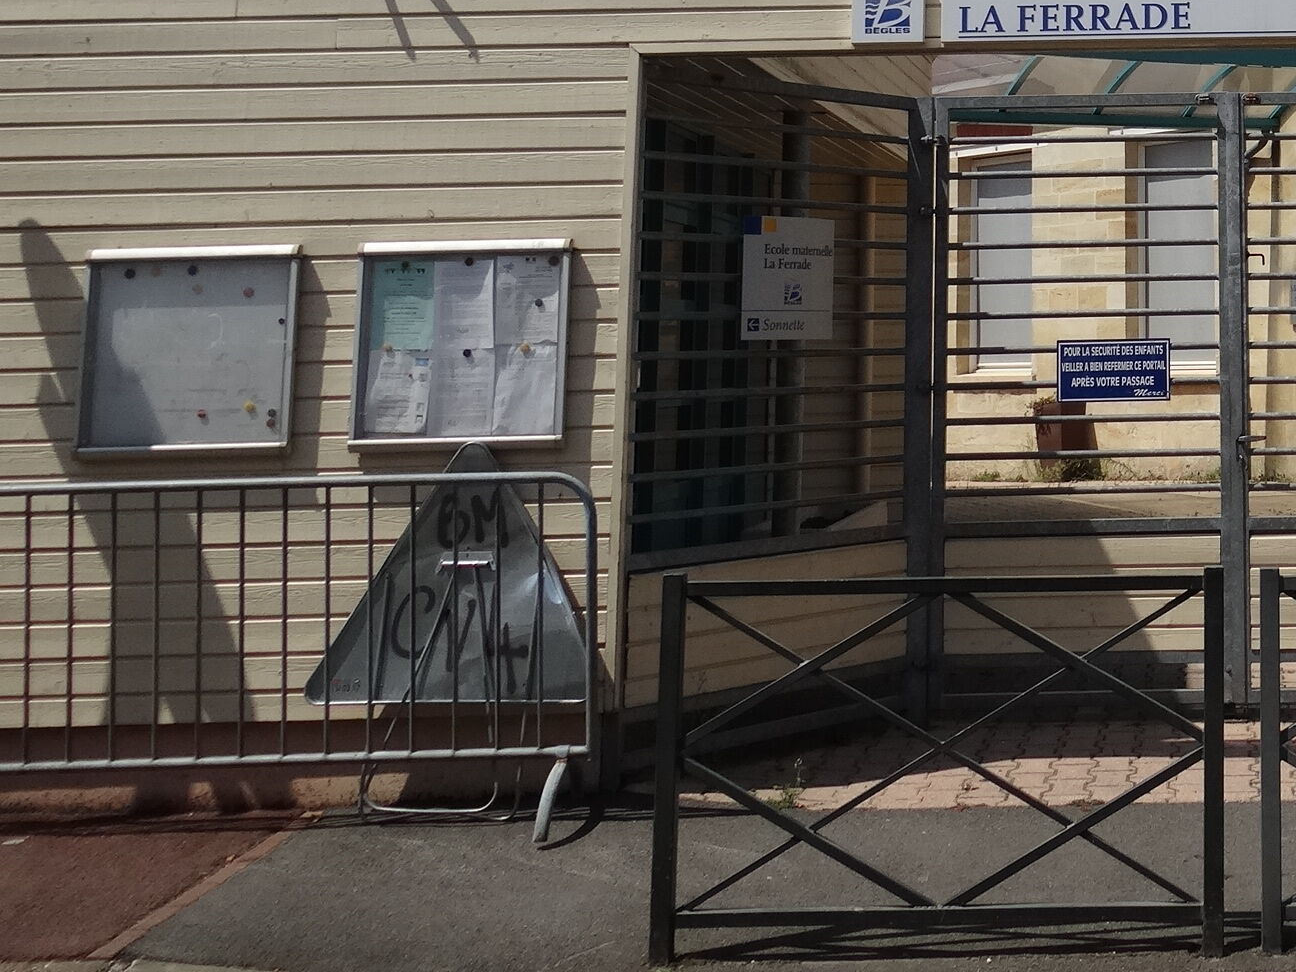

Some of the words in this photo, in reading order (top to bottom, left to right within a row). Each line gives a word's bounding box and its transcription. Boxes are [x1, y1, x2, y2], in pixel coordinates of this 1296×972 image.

[959, 5, 1005, 33] LA
[1017, 2, 1191, 32] FERRADE
[764, 243, 790, 255] Ecole
[792, 245, 833, 258] maternelle
[763, 258, 775, 269] La
[777, 258, 812, 270] Ferrade
[762, 318, 806, 332] Sonnette
[1064, 347, 1081, 357] POUR
[1082, 347, 1090, 356] LA
[1121, 346, 1133, 355] DES
[1134, 345, 1164, 355] ENFANTS
[1062, 362, 1083, 372] VEILLER
[1084, 362, 1089, 371] A
[1090, 362, 1103, 371] BIEN
[1103, 361, 1134, 371] REFERMER
[1134, 361, 1142, 371] CE
[1142, 360, 1166, 370] PORTAIL
[1071, 375, 1095, 387] APRÈS
[1096, 376, 1120, 387] VOTRE
[1121, 375, 1155, 386] PASSAGE
[1133, 388, 1165, 397] Merci
